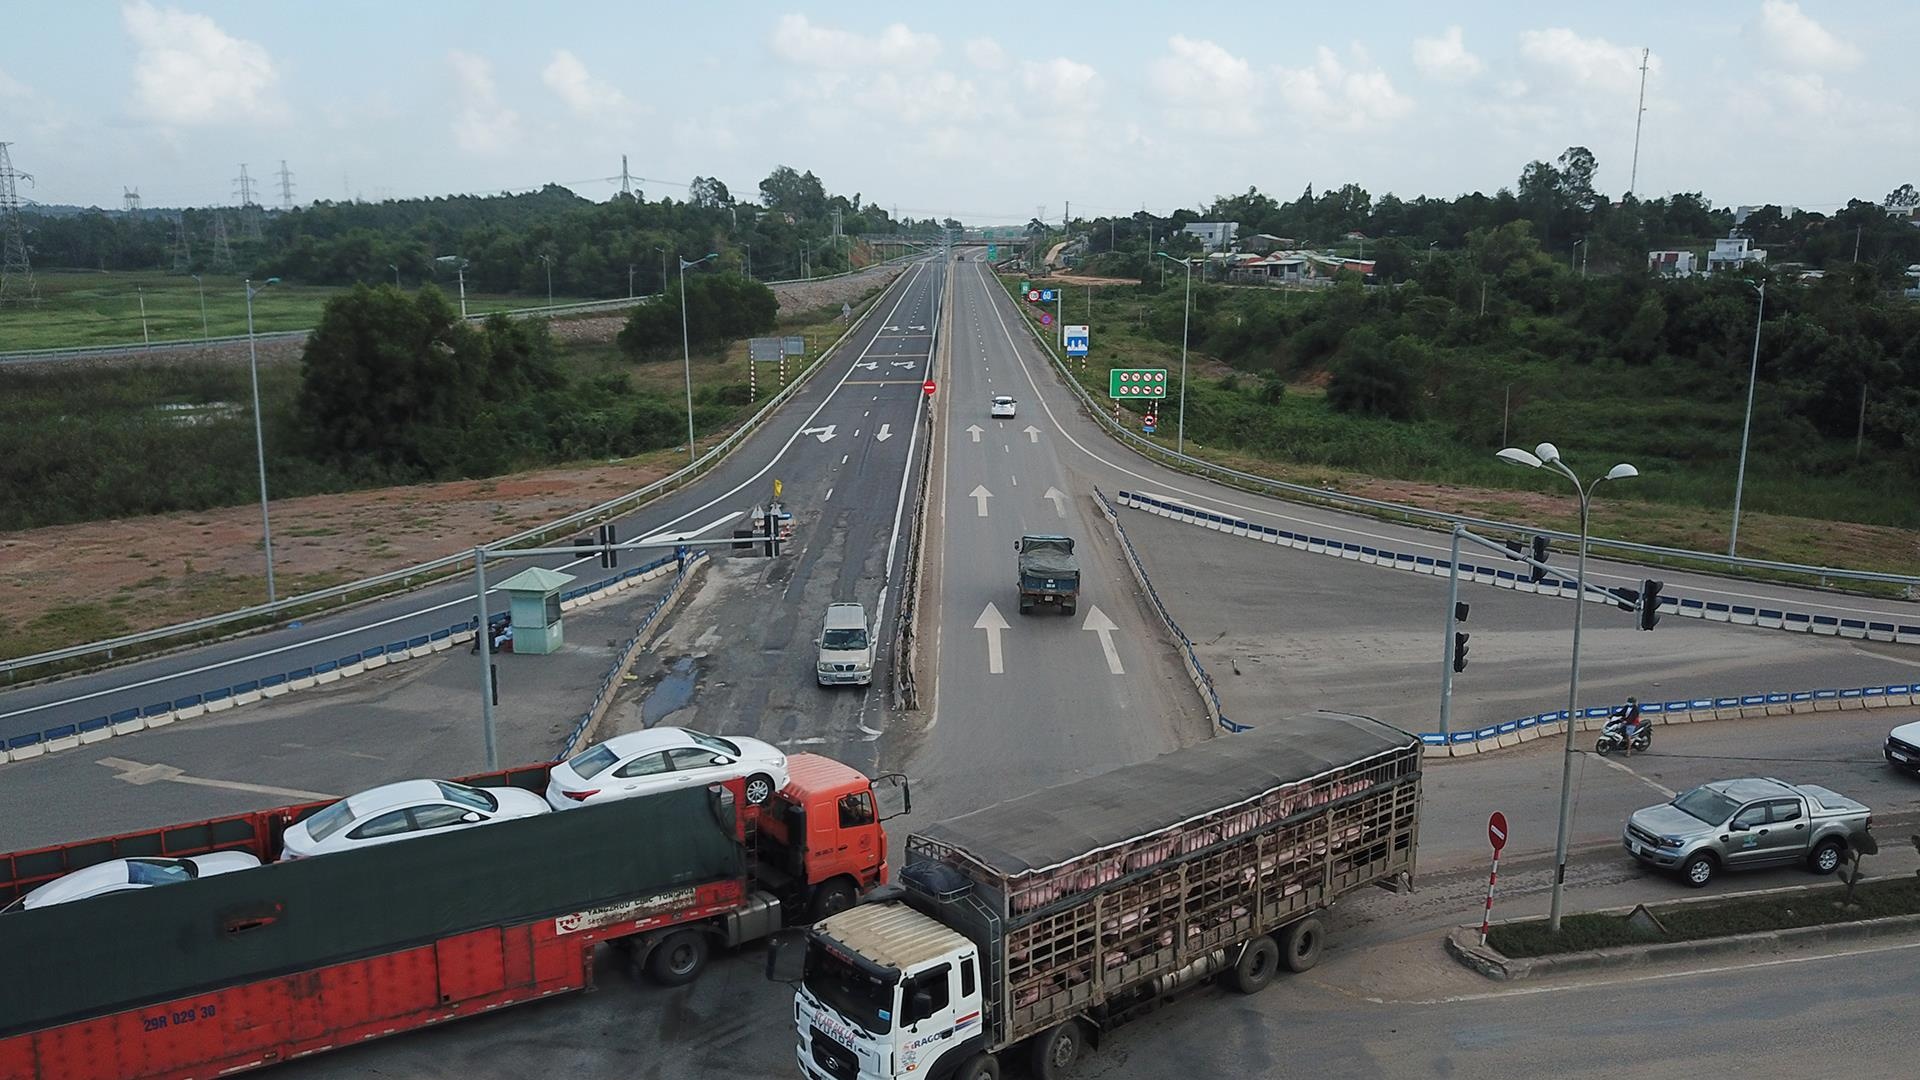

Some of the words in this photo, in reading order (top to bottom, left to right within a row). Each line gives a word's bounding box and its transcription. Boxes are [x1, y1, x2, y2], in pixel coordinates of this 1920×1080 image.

[1042, 290, 1051, 300] 60
[144, 1015, 168, 1032] 29R
[172, 1009, 195, 1025] 029
[200, 1004, 216, 1019] 30
